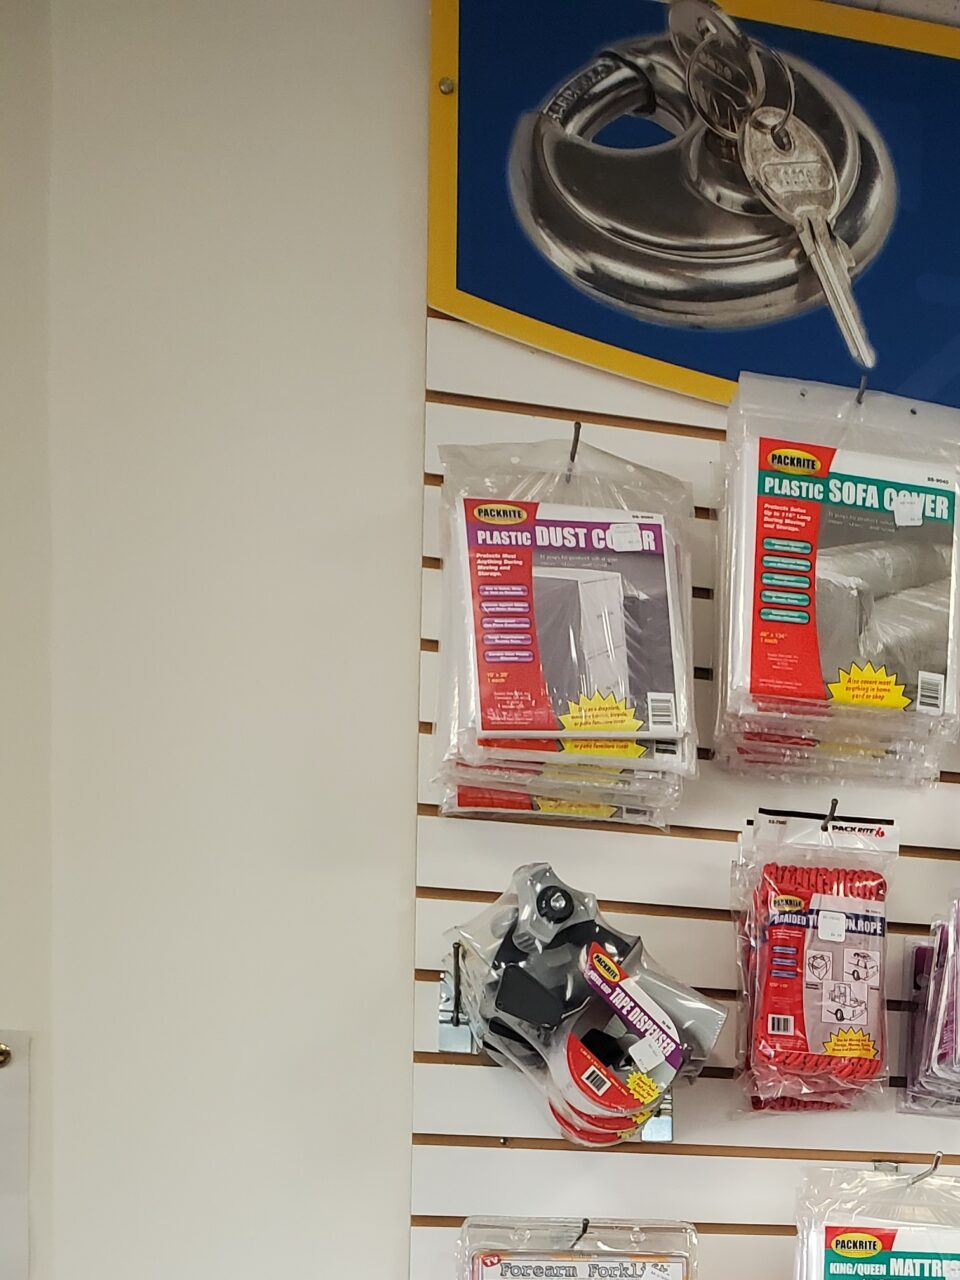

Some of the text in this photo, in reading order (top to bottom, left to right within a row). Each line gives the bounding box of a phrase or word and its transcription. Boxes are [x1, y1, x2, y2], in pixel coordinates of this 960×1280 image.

[771, 453, 817, 470] PACKRITE
[764, 477, 824, 499] PLASTIC
[829, 479, 880, 508] SOFA
[477, 508, 522, 519] PACKRITE
[477, 526, 655, 550] PLASTIC DUST COR
[857, 921, 882, 934] ROPE
[593, 954, 618, 979] PACKRITE
[610, 987, 632, 1014] TAPE
[627, 1009, 676, 1056] DISPENSER
[835, 1239, 877, 1250] PACKRITE
[500, 1261, 668, 1278] Forearm Forkl
[829, 1262, 887, 1276] KING/QUEEN
